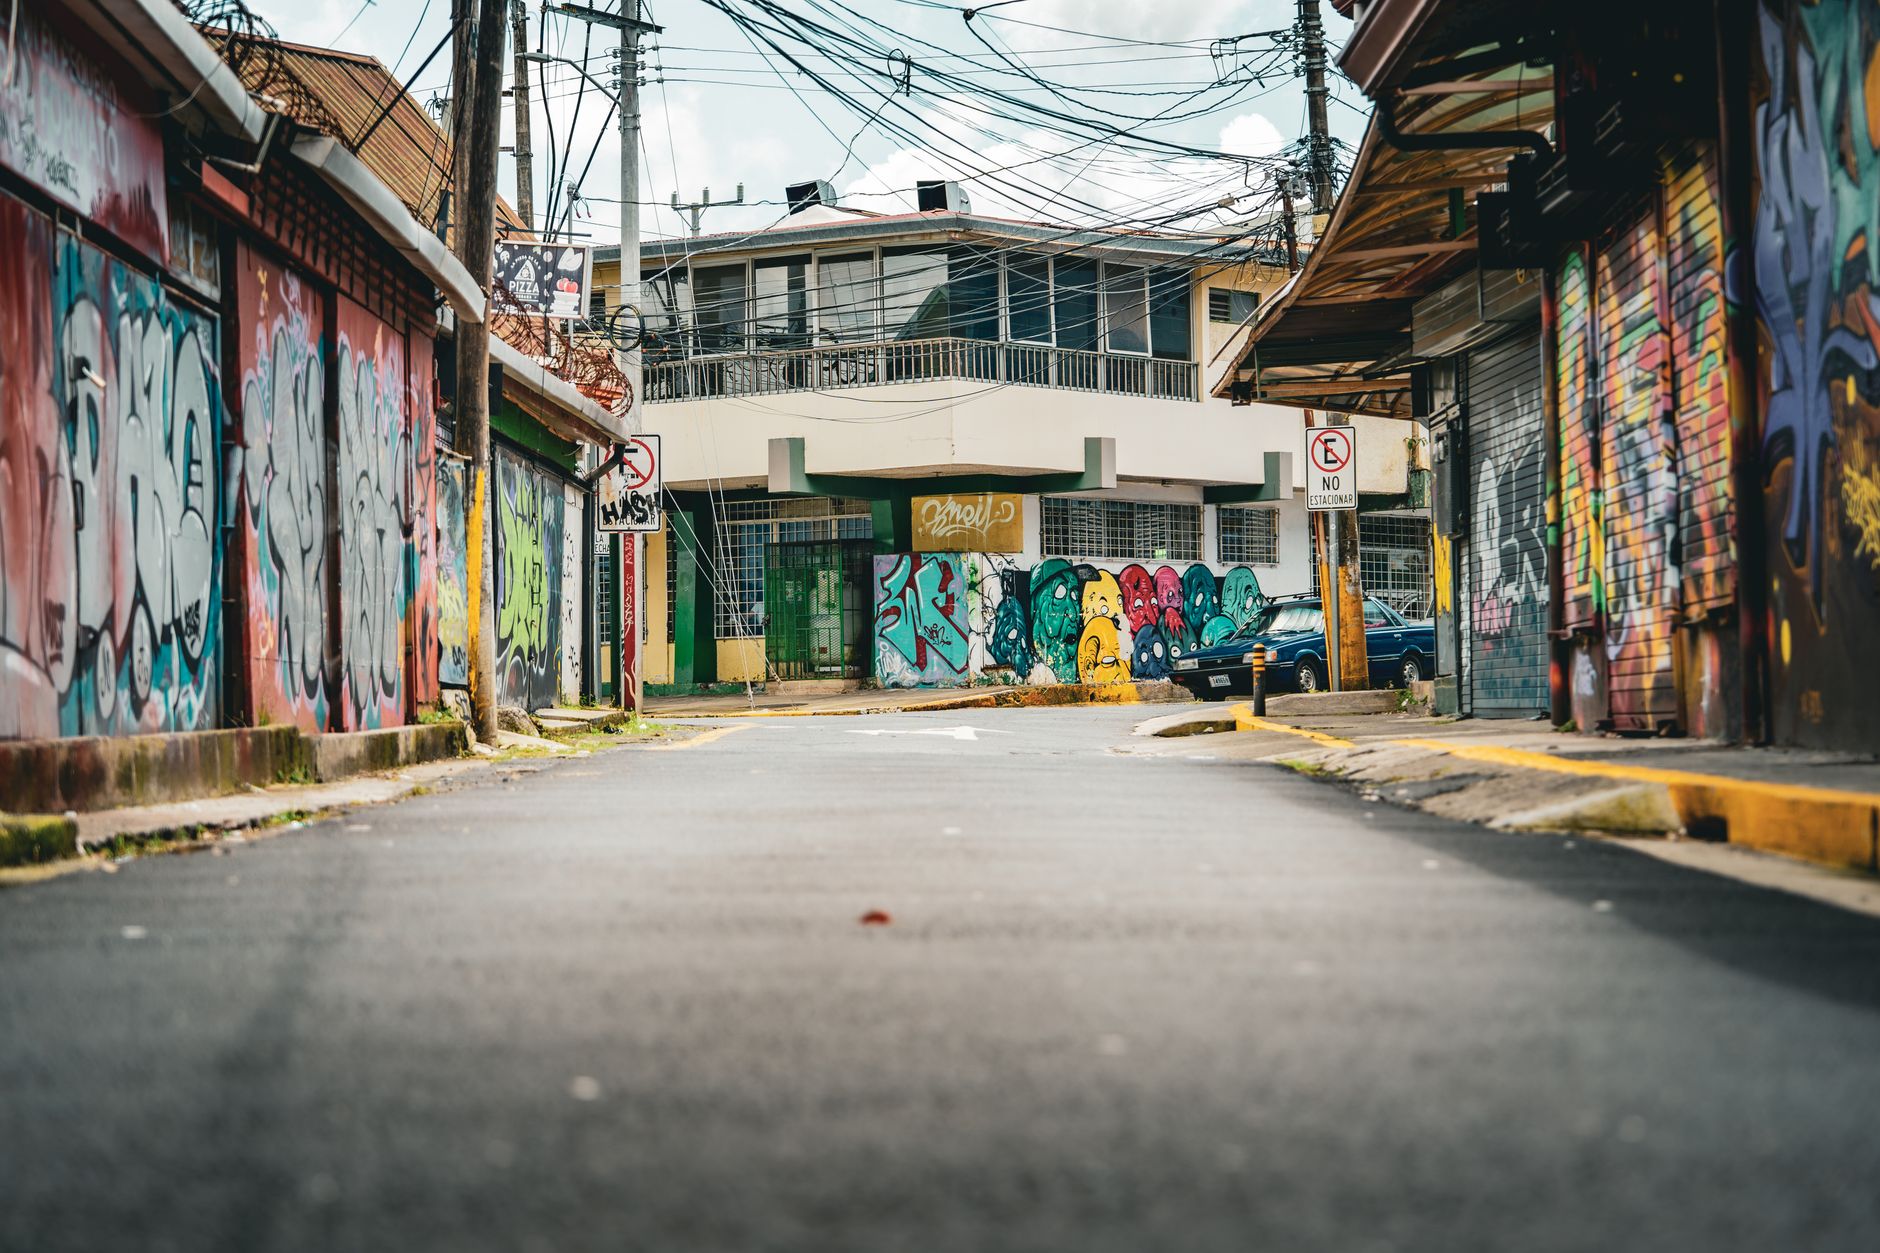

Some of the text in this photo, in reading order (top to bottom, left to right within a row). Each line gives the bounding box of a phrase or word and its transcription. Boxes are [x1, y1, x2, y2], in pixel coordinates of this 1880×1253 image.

[509, 280, 540, 293] PIZZA
[1322, 475, 1340, 491] NO
[1309, 493, 1354, 506] ESTACIONAR
[595, 543, 610, 553] ECHA
